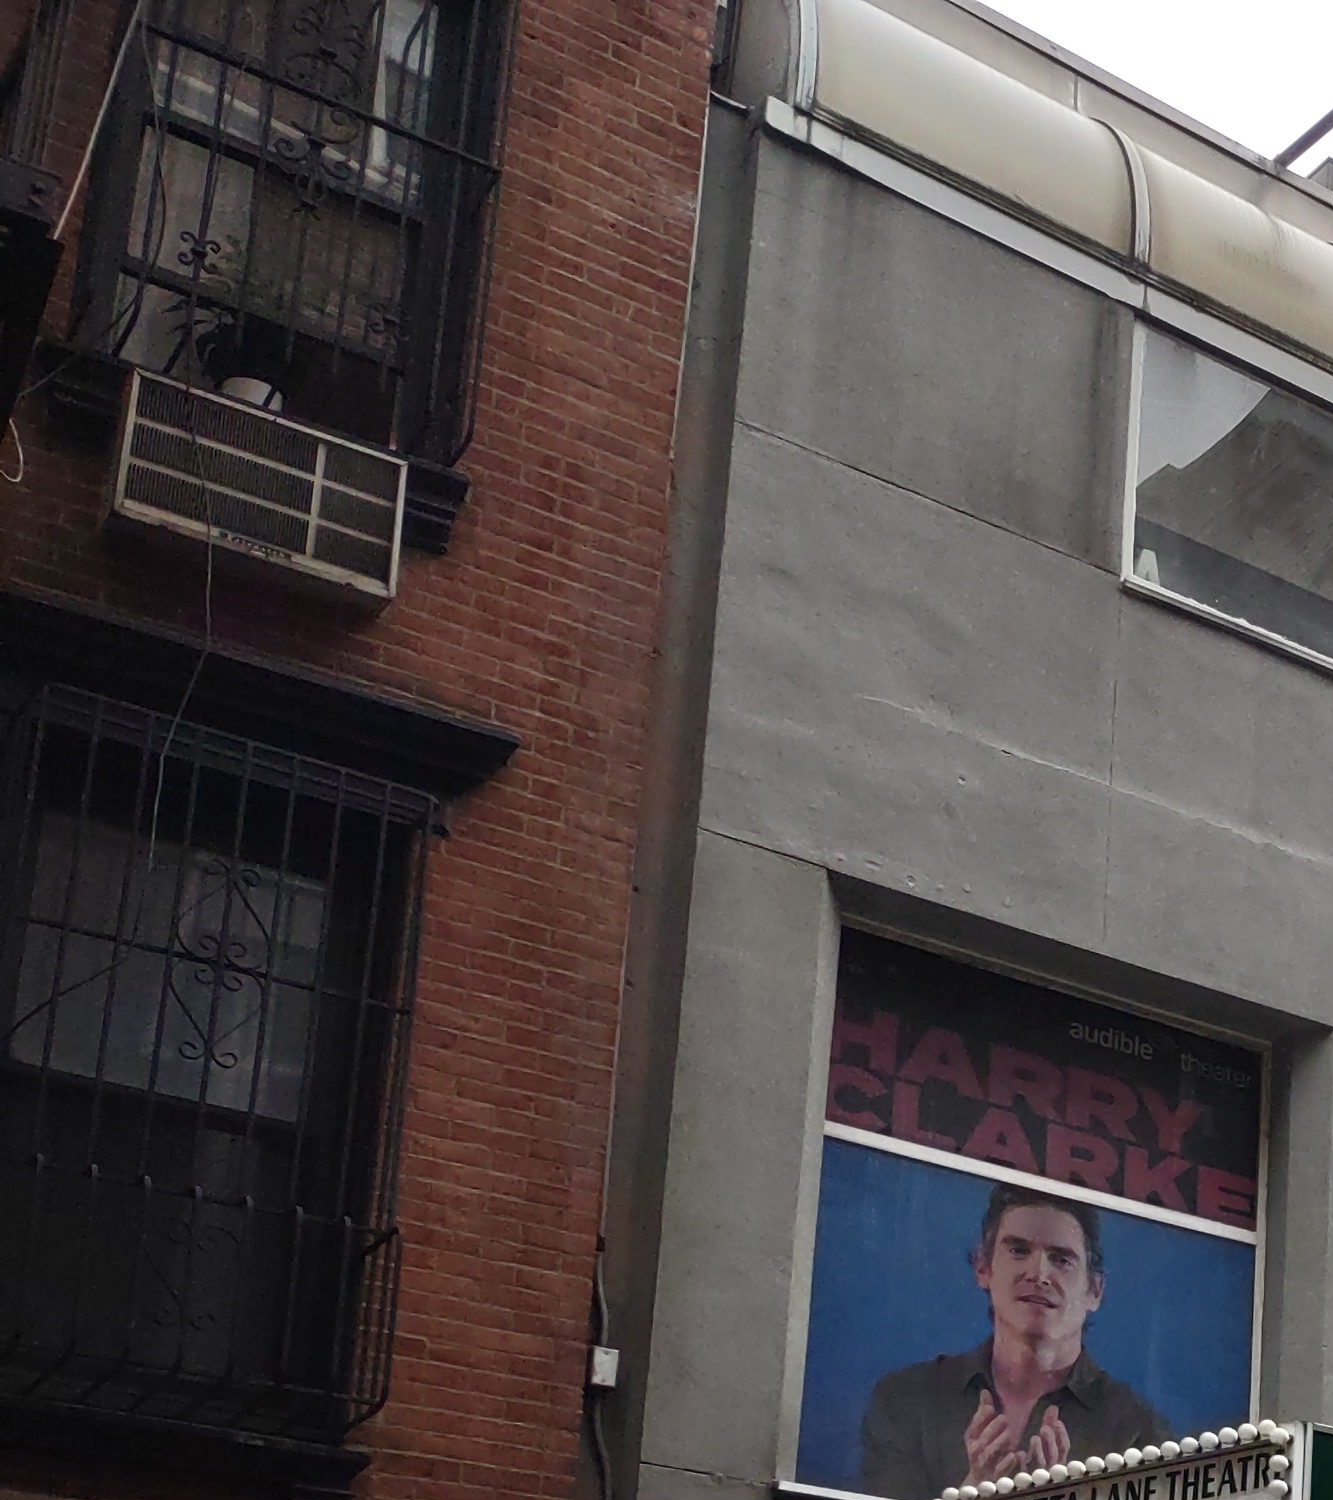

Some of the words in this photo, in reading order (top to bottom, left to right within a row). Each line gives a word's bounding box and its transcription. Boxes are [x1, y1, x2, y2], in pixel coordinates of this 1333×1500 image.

[831, 1010, 1211, 1151] HARRY
[1069, 1021, 1154, 1061] audible
[1180, 1052, 1254, 1089] theater
[827, 1063, 1258, 1231] CLARKE
